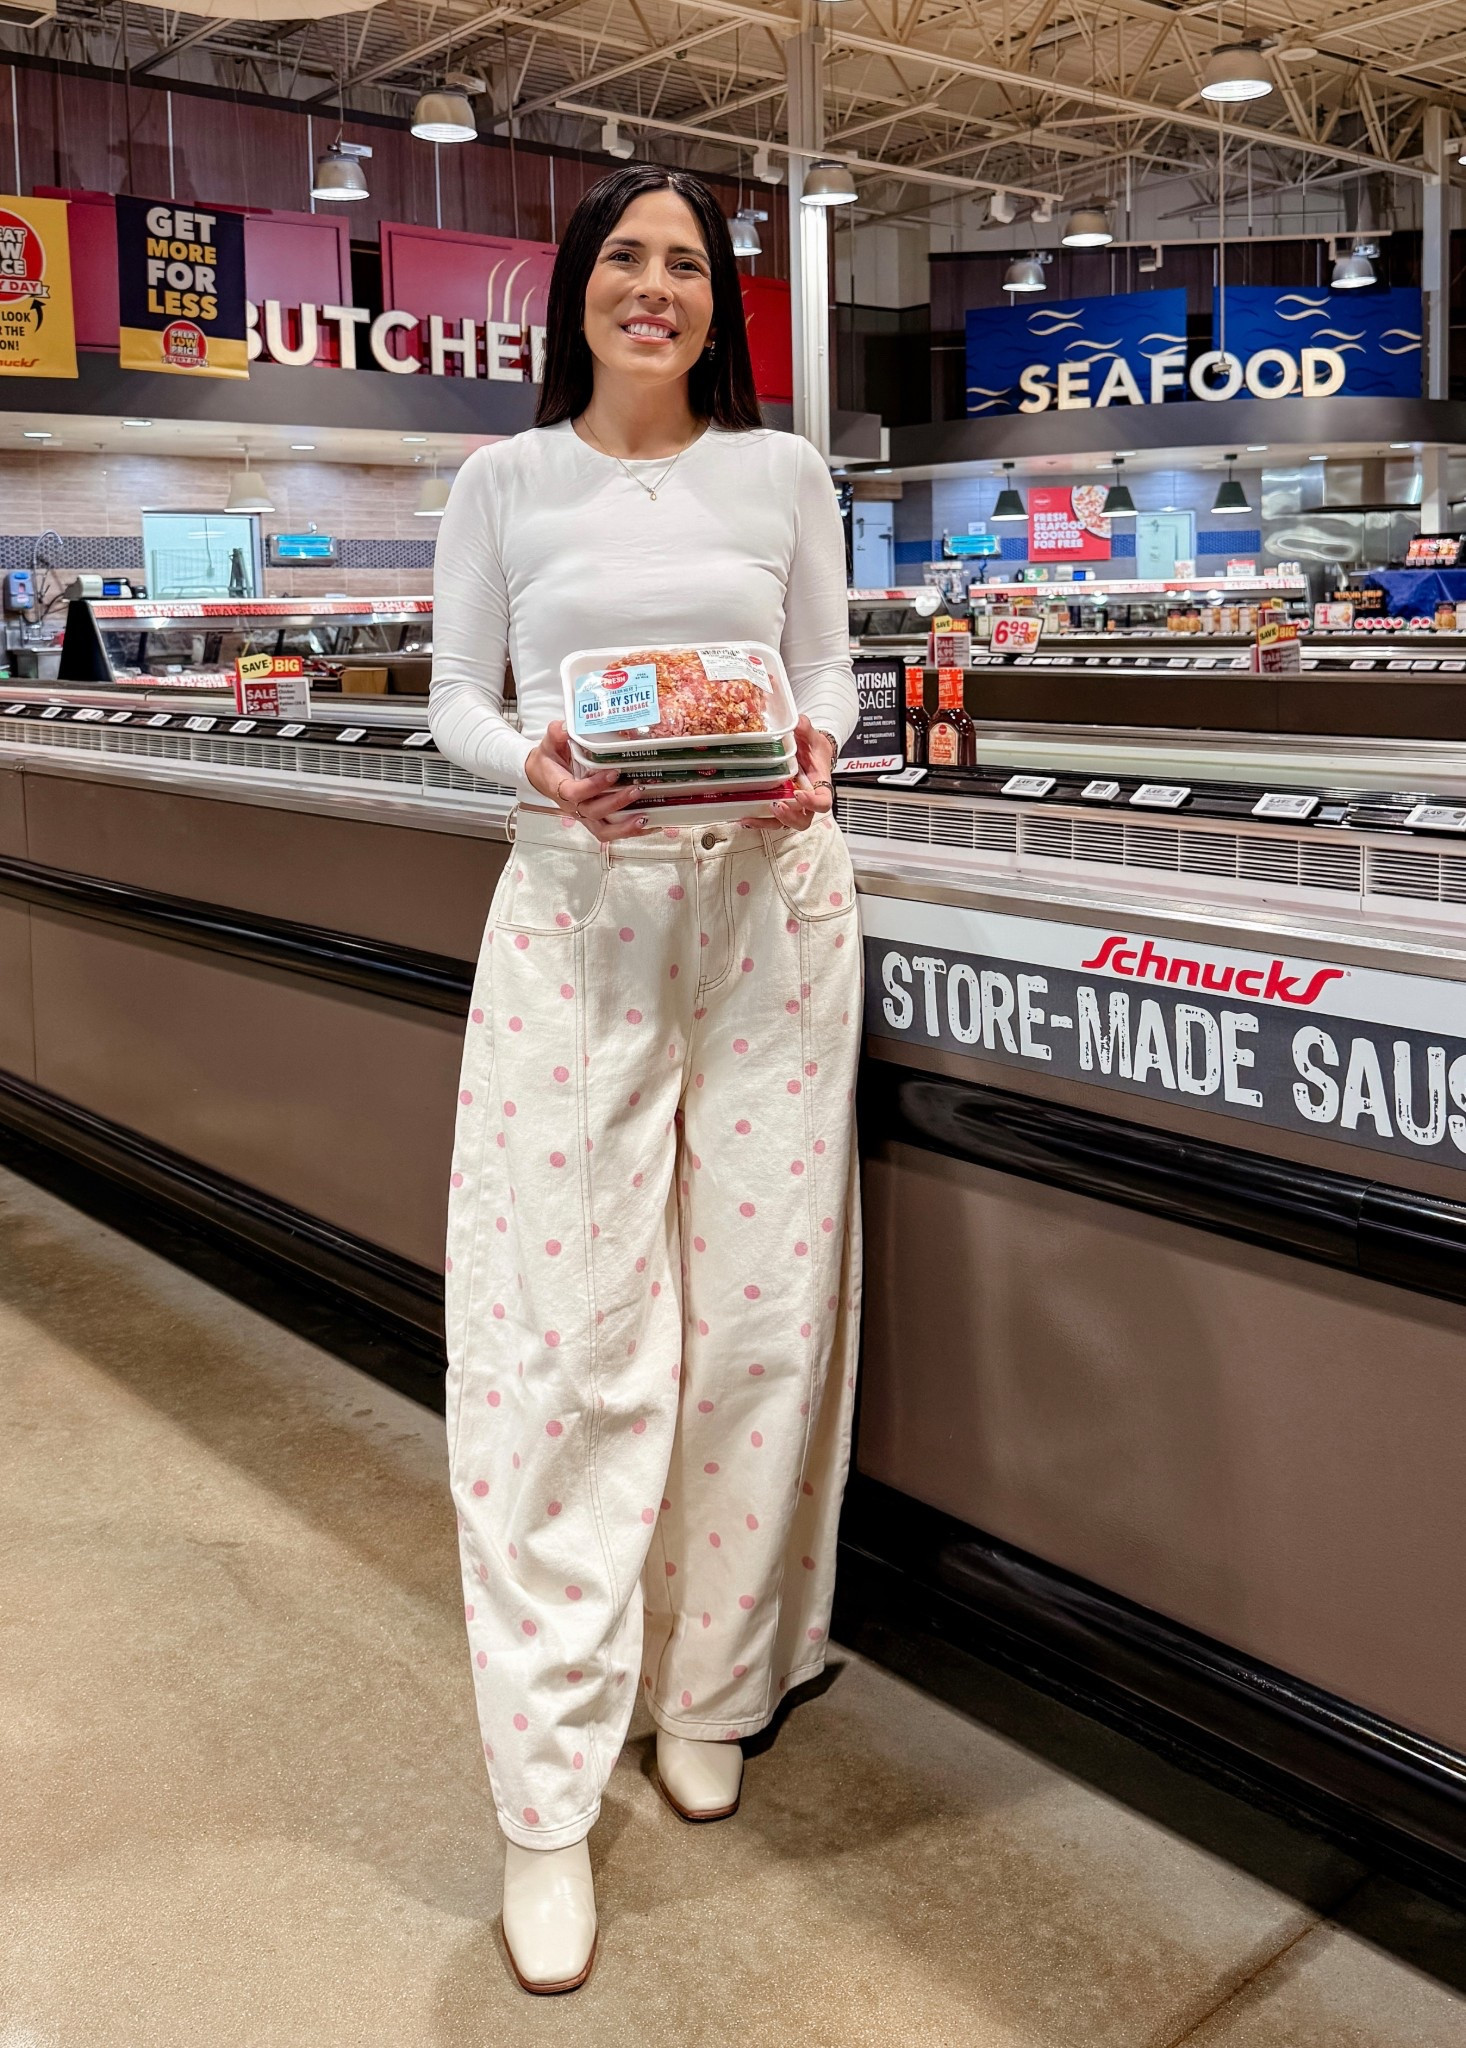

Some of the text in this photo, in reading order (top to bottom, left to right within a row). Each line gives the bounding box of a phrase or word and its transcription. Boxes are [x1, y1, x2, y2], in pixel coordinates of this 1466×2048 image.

[146, 206, 216, 243] GET
[147, 238, 217, 265] MORE
[147, 258, 217, 294] FOR
[10, 281, 38, 292] DAY
[148, 288, 218, 321] LESS
[2, 311, 31, 322] LOOK
[5, 326, 25, 336] THE
[171, 330, 198, 340] GREAT
[172, 336, 197, 348] LOW
[171, 346, 197, 355] PRICE
[1018, 347, 1346, 415] SEAFOOD
[1034, 512, 1068, 522] FRESH
[1034, 521, 1086, 532] SEAFOOD
[1034, 531, 1080, 541] COOKED
[1034, 538, 1084, 549] FOR FREE
[936, 620, 967, 631] SAVE BIG
[1260, 626, 1295, 640] SAVE BIG
[241, 659, 300, 673] SAVE BIG
[854, 672, 897, 690] RTISAN
[247, 689, 277, 700] SALE
[582, 690, 651, 713] COUTRY STYLE
[586, 708, 620, 720] BREAAST
[622, 701, 649, 713] SAUSAGE
[843, 757, 897, 770] Schnucks
[1082, 936, 1345, 1006] Schnucks
[881, 951, 1263, 1108] STORE-MADE
